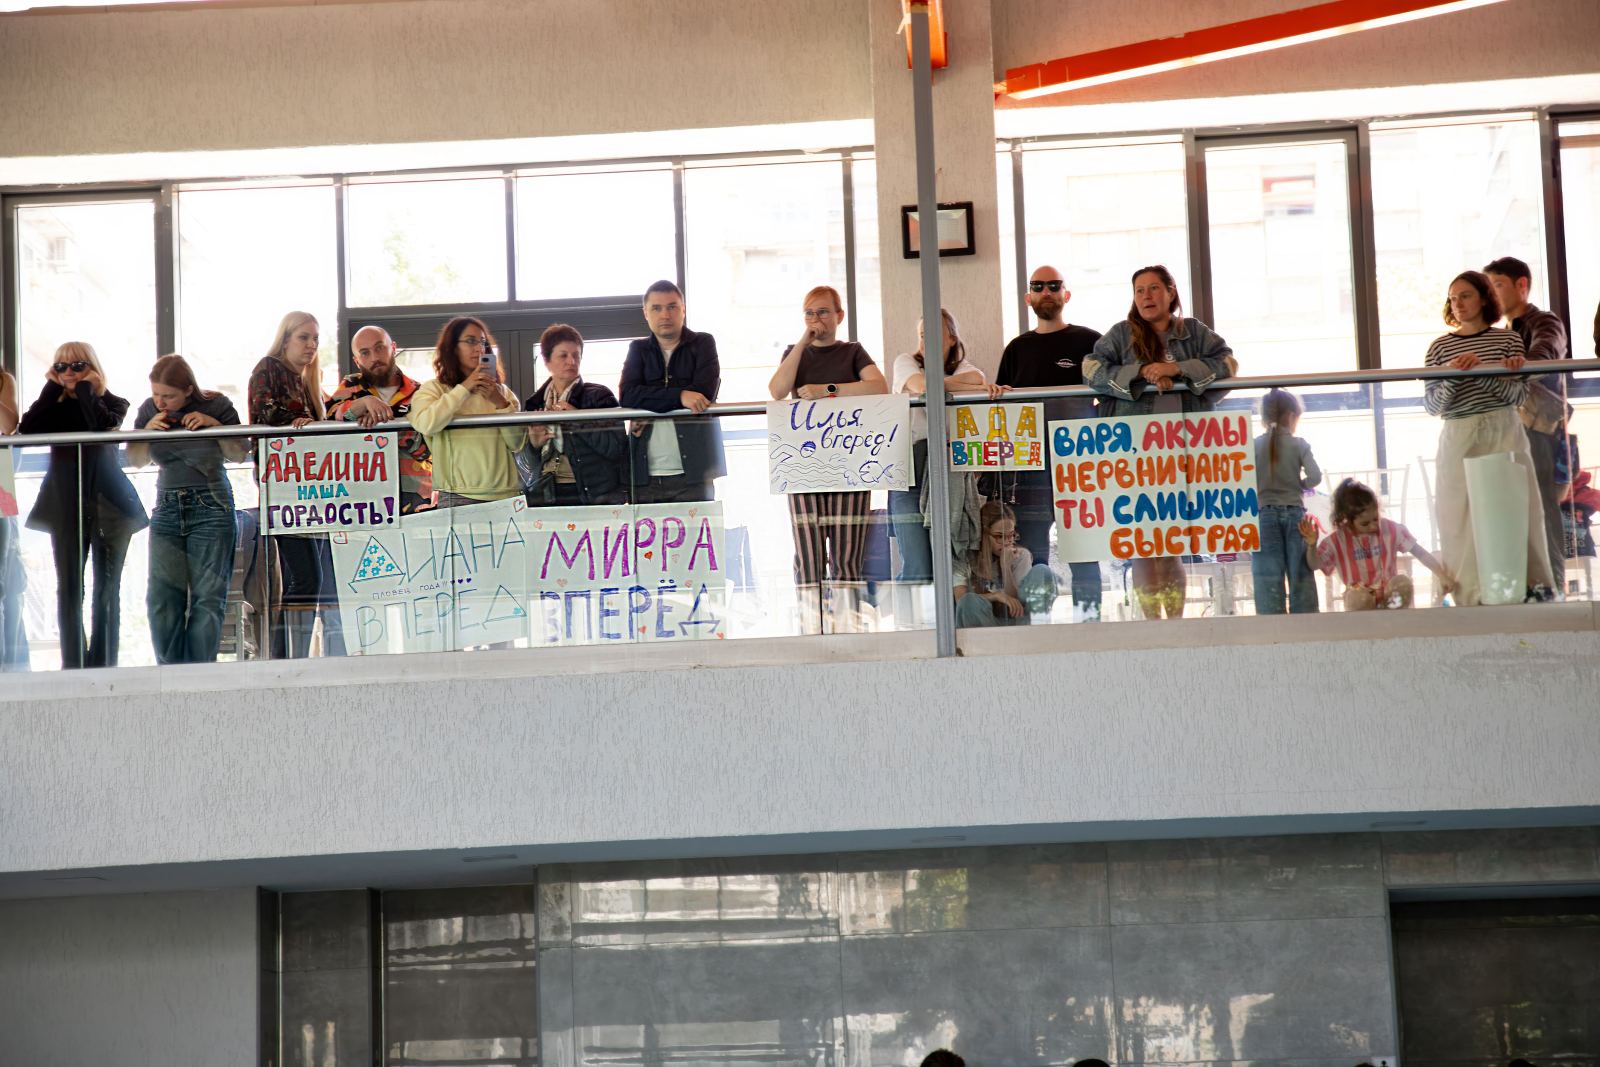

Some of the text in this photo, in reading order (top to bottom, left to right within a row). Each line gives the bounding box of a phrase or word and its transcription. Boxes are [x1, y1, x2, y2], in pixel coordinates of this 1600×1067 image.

[820, 424, 899, 456] вперёд!
[956, 406, 1038, 441] АДА
[1053, 416, 1248, 457] ВАРЯ, АКУЛЫ
[261, 451, 388, 483] АДЕЛИНА
[297, 483, 350, 500] НАША
[1055, 487, 1259, 530] ТЫ СЛИШКОМ
[268, 496, 395, 529] ГОРДОСТЬ!
[348, 516, 526, 594] ДИАНА
[540, 516, 719, 581] МИРРА
[1109, 523, 1260, 560] БЫСТРАЯ
[372, 588, 412, 600] ПЛОВЕЦ
[539, 579, 721, 643] ВПЕРЁД
